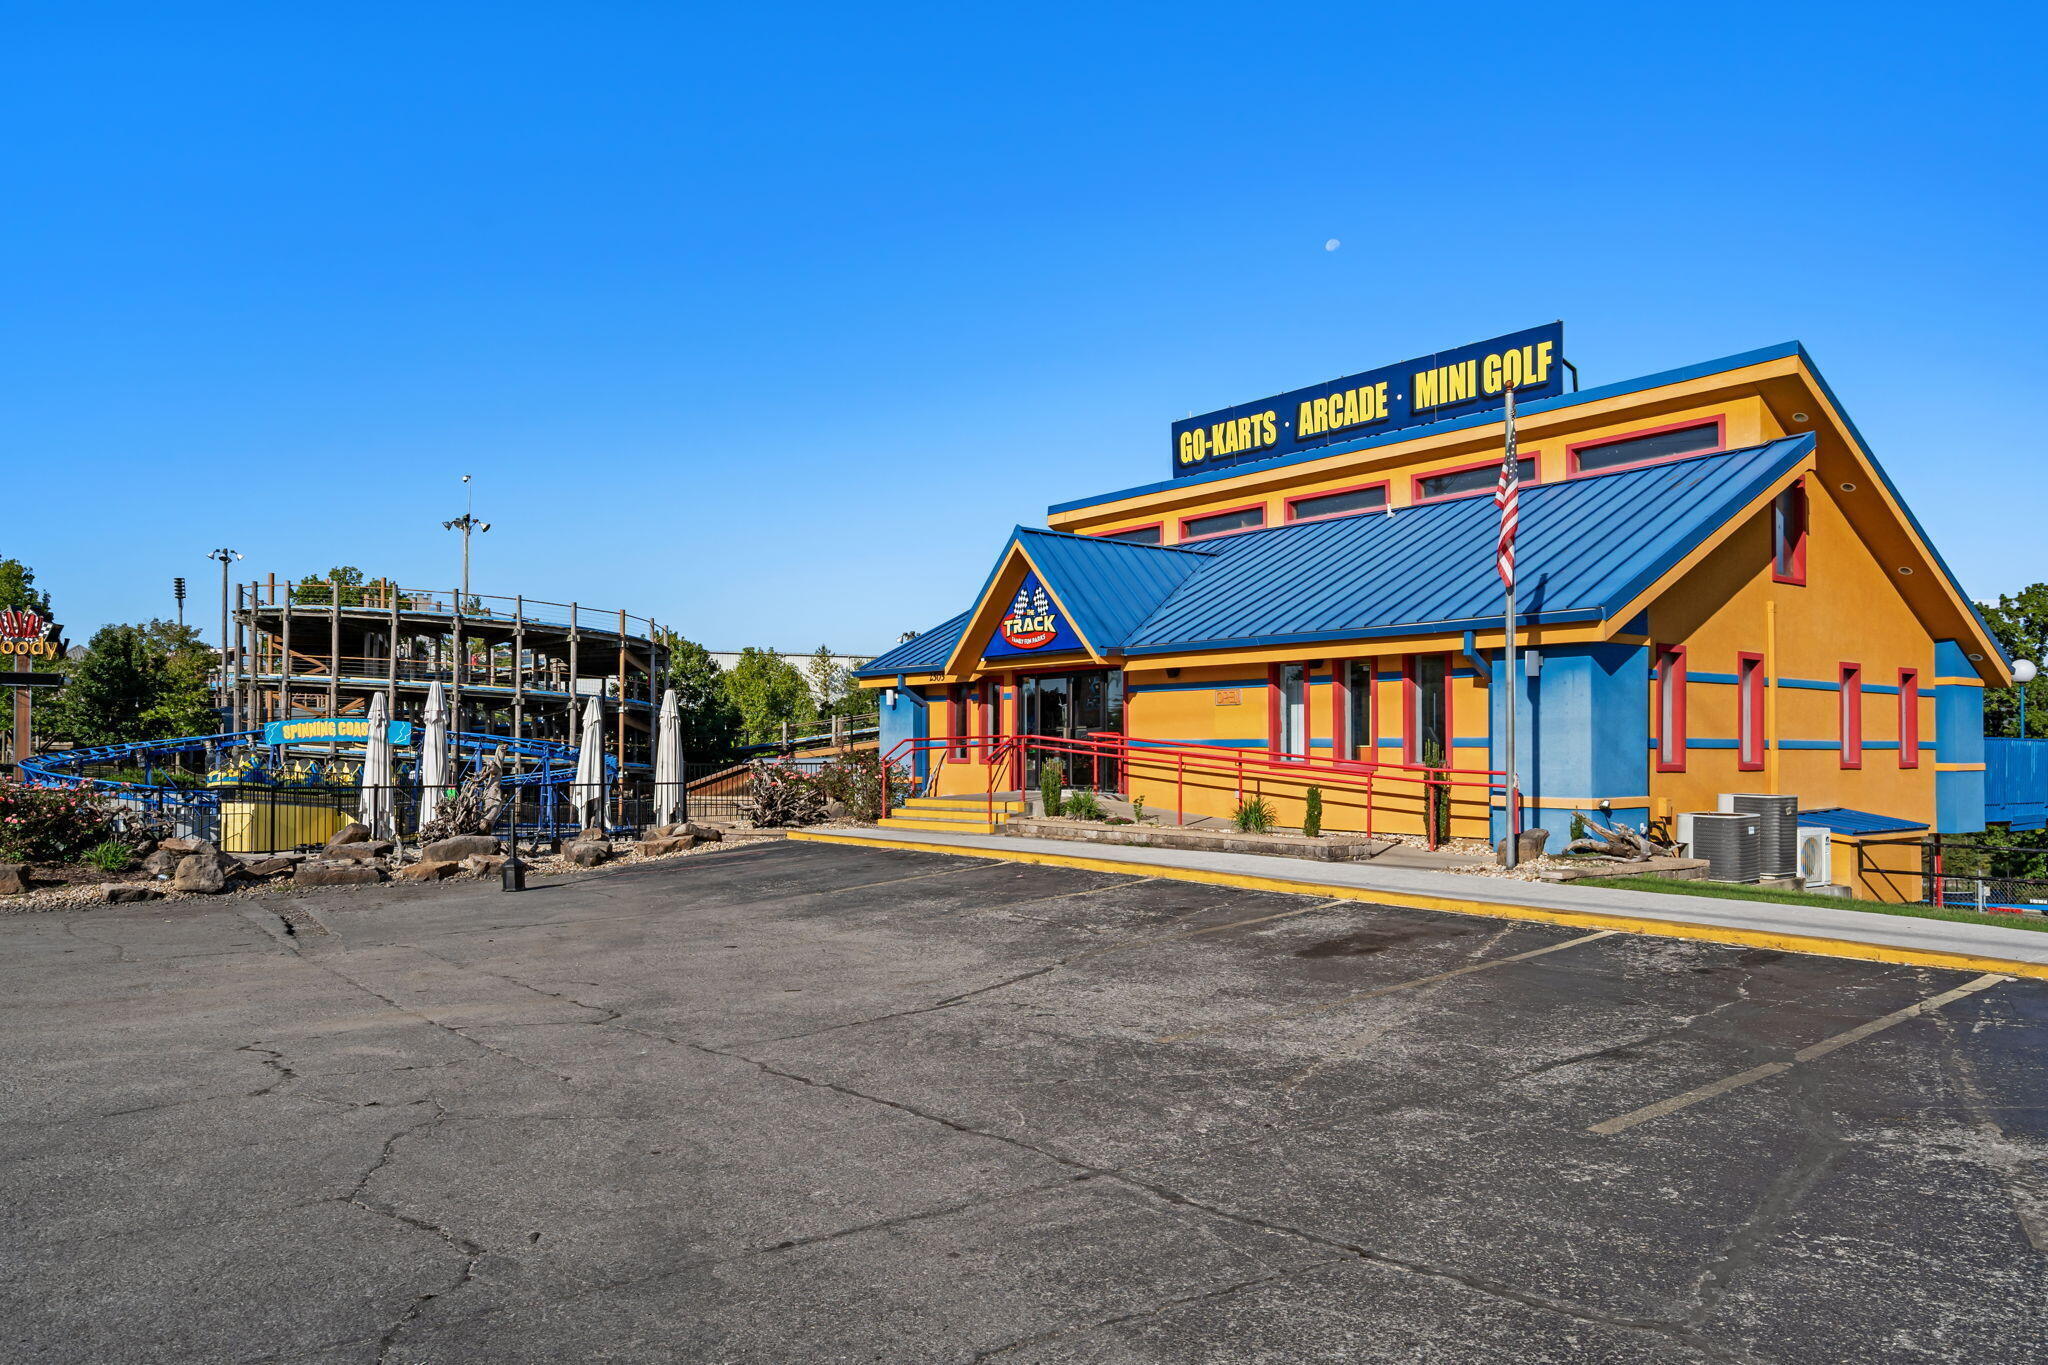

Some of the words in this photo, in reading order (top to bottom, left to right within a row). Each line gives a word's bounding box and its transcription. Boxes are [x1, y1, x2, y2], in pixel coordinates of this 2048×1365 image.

[1415, 359, 1477, 410] MINI
[1483, 340, 1553, 394] GOLF
[1298, 382, 1388, 437] ARCADE
[1180, 410, 1277, 464] GO-KARTS
[1003, 614, 1056, 637] TRACK
[0, 636, 58, 661] oody
[283, 721, 336, 740] SPINNING
[338, 722, 369, 737] COAS
